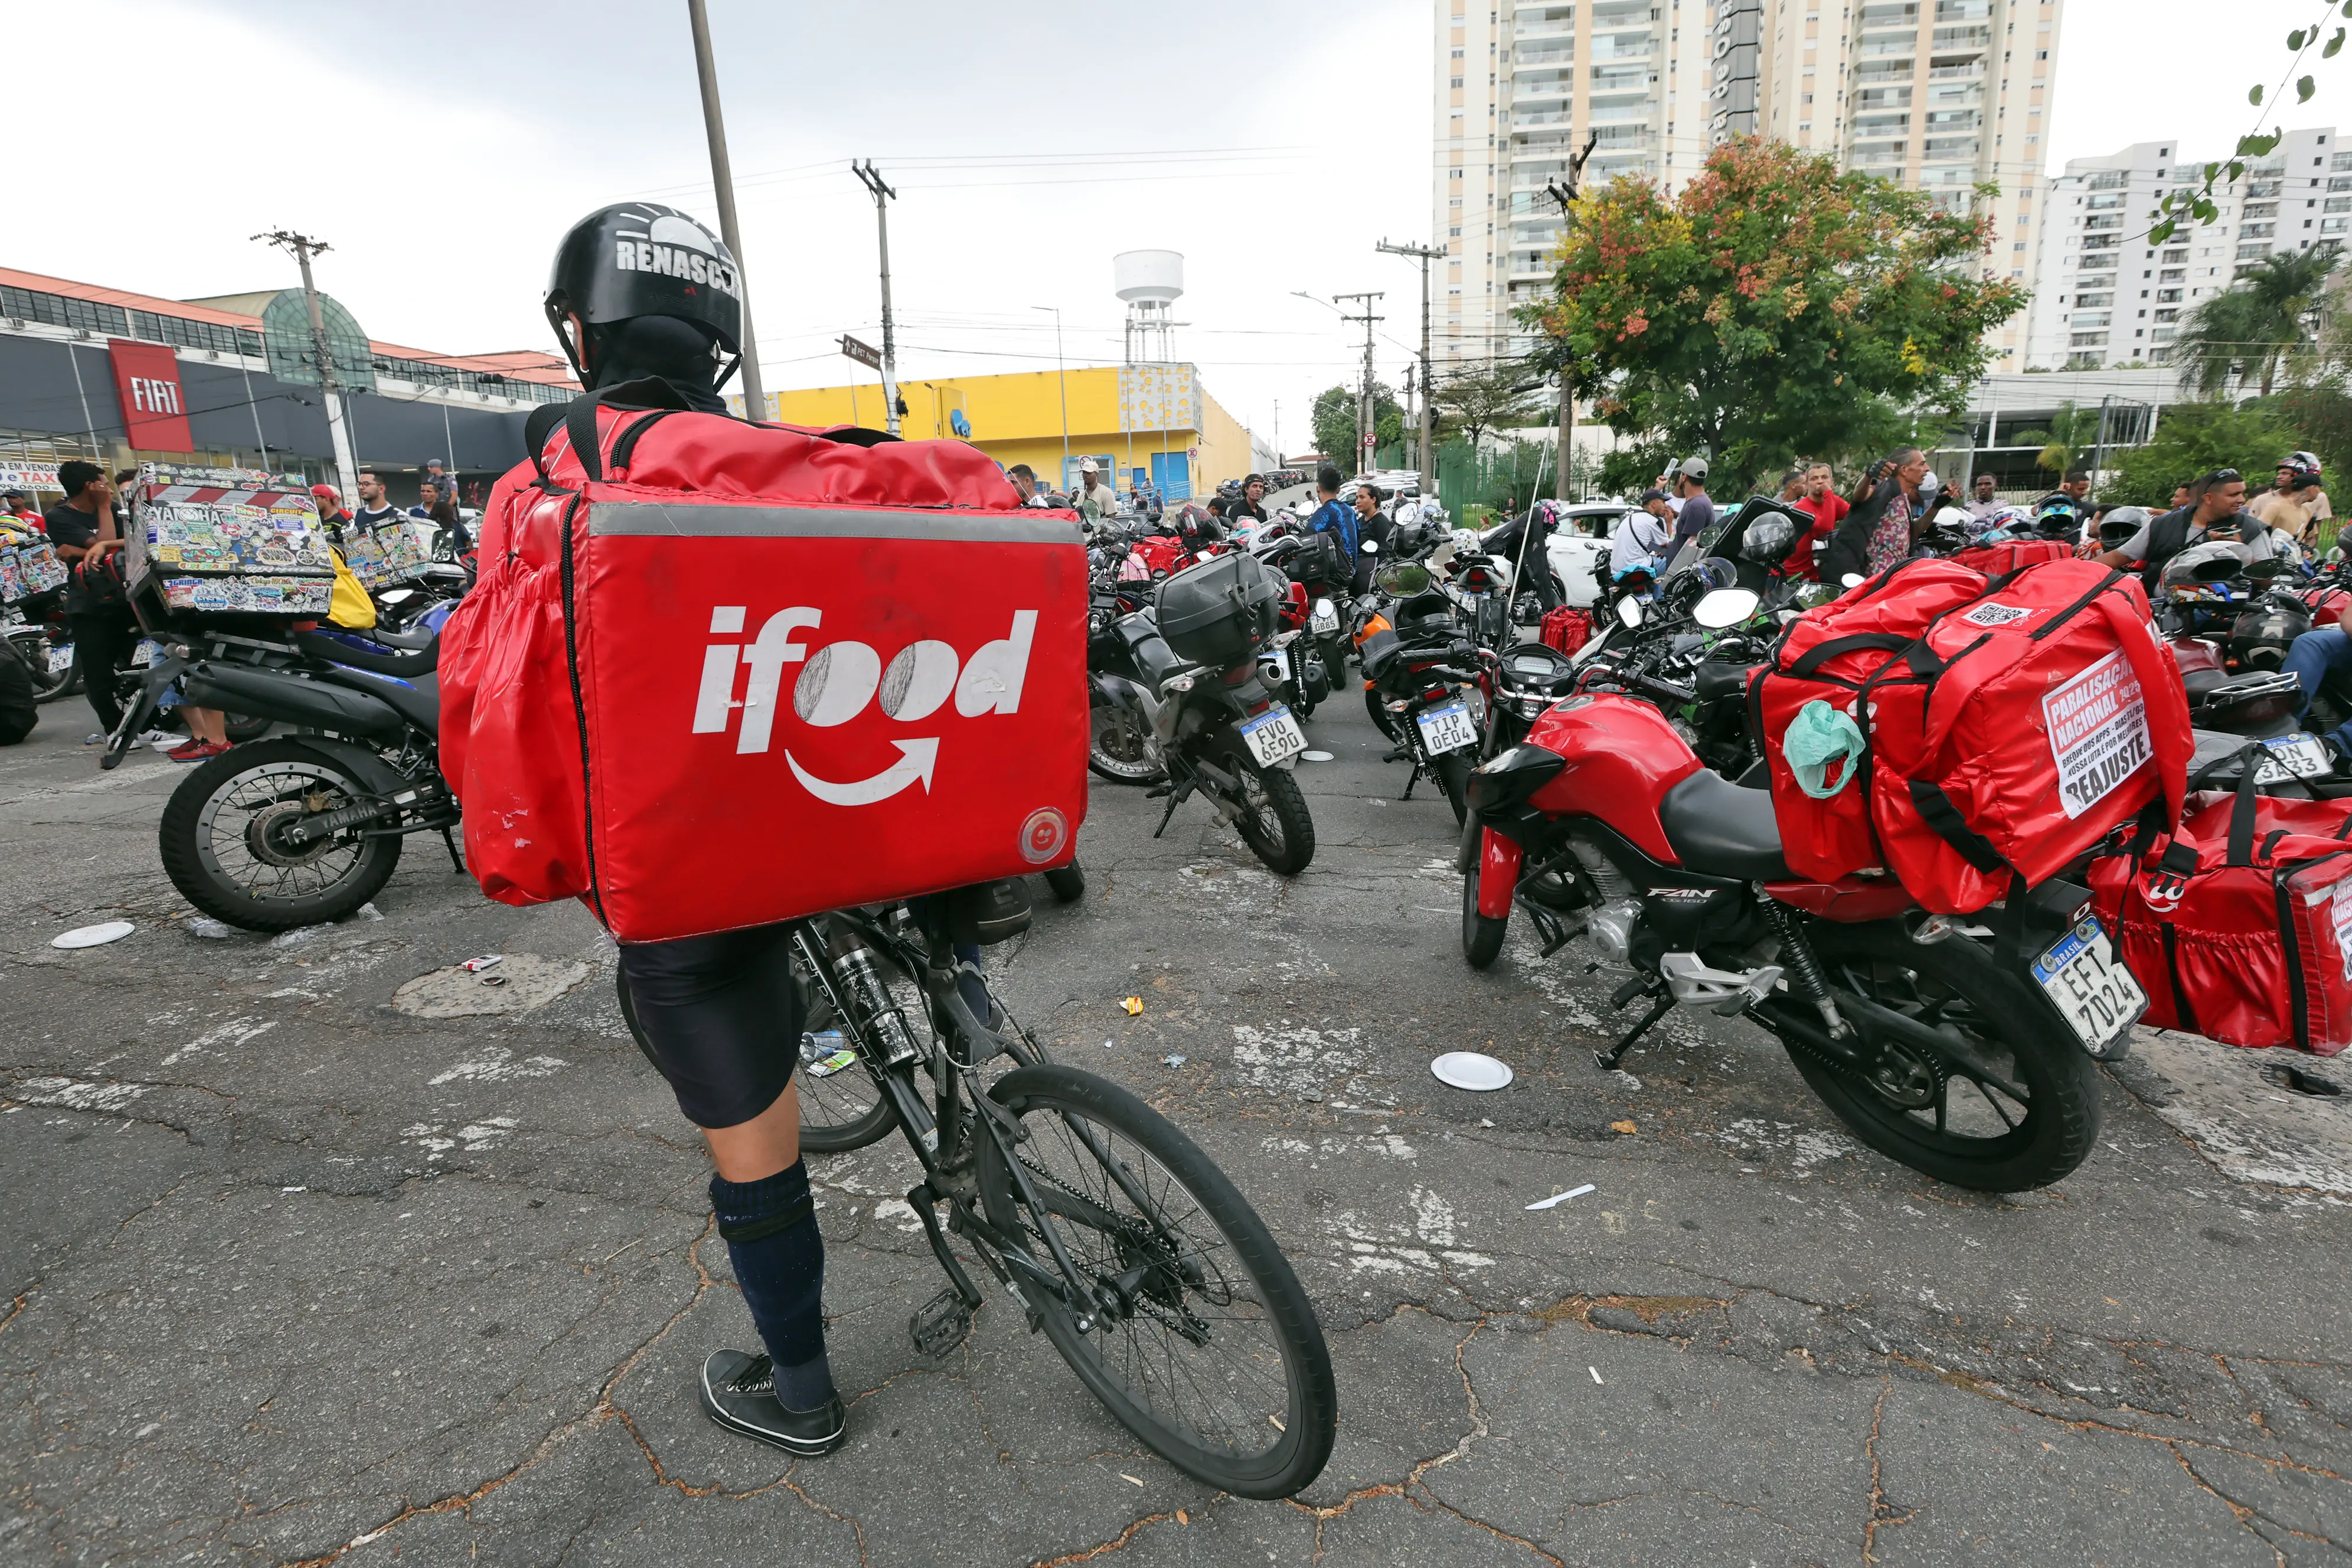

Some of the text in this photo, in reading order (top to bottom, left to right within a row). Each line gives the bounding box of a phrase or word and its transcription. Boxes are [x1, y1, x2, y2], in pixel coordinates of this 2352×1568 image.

[857, 347, 879, 364] PET Parque
[130, 376, 180, 414] FIAT
[8, 462, 23, 471] EM
[25, 463, 61, 473] VENDAS
[18, 472, 61, 483] TAX
[153, 506, 222, 525] YAHA
[692, 605, 1039, 755] ifood
[1255, 716, 1275, 728] BRASIL
[1430, 714, 1459, 734] TIP
[1432, 710, 1452, 720] BRASIL
[2055, 690, 2119, 750] NACIONAL
[1261, 732, 1300, 761] 6E90
[1432, 727, 1471, 750] 0E04
[2062, 746, 2083, 769] BREQUE
[2083, 737, 2095, 752] DOS
[2096, 728, 2111, 744] APPS
[2115, 714, 2128, 731] DIAS
[2088, 749, 2101, 764] LUTA
[2101, 743, 2106, 754] É
[2105, 739, 2117, 752] POR
[2118, 718, 2142, 741] MELHORES
[319, 804, 377, 829] YAMAHA
[1647, 887, 1719, 898] FAN
[2054, 940, 2083, 967] BRASIL
[2060, 946, 2108, 1002] EFT
[2077, 974, 2136, 1039] 7D24
[2086, 1035, 2099, 1053] BR
